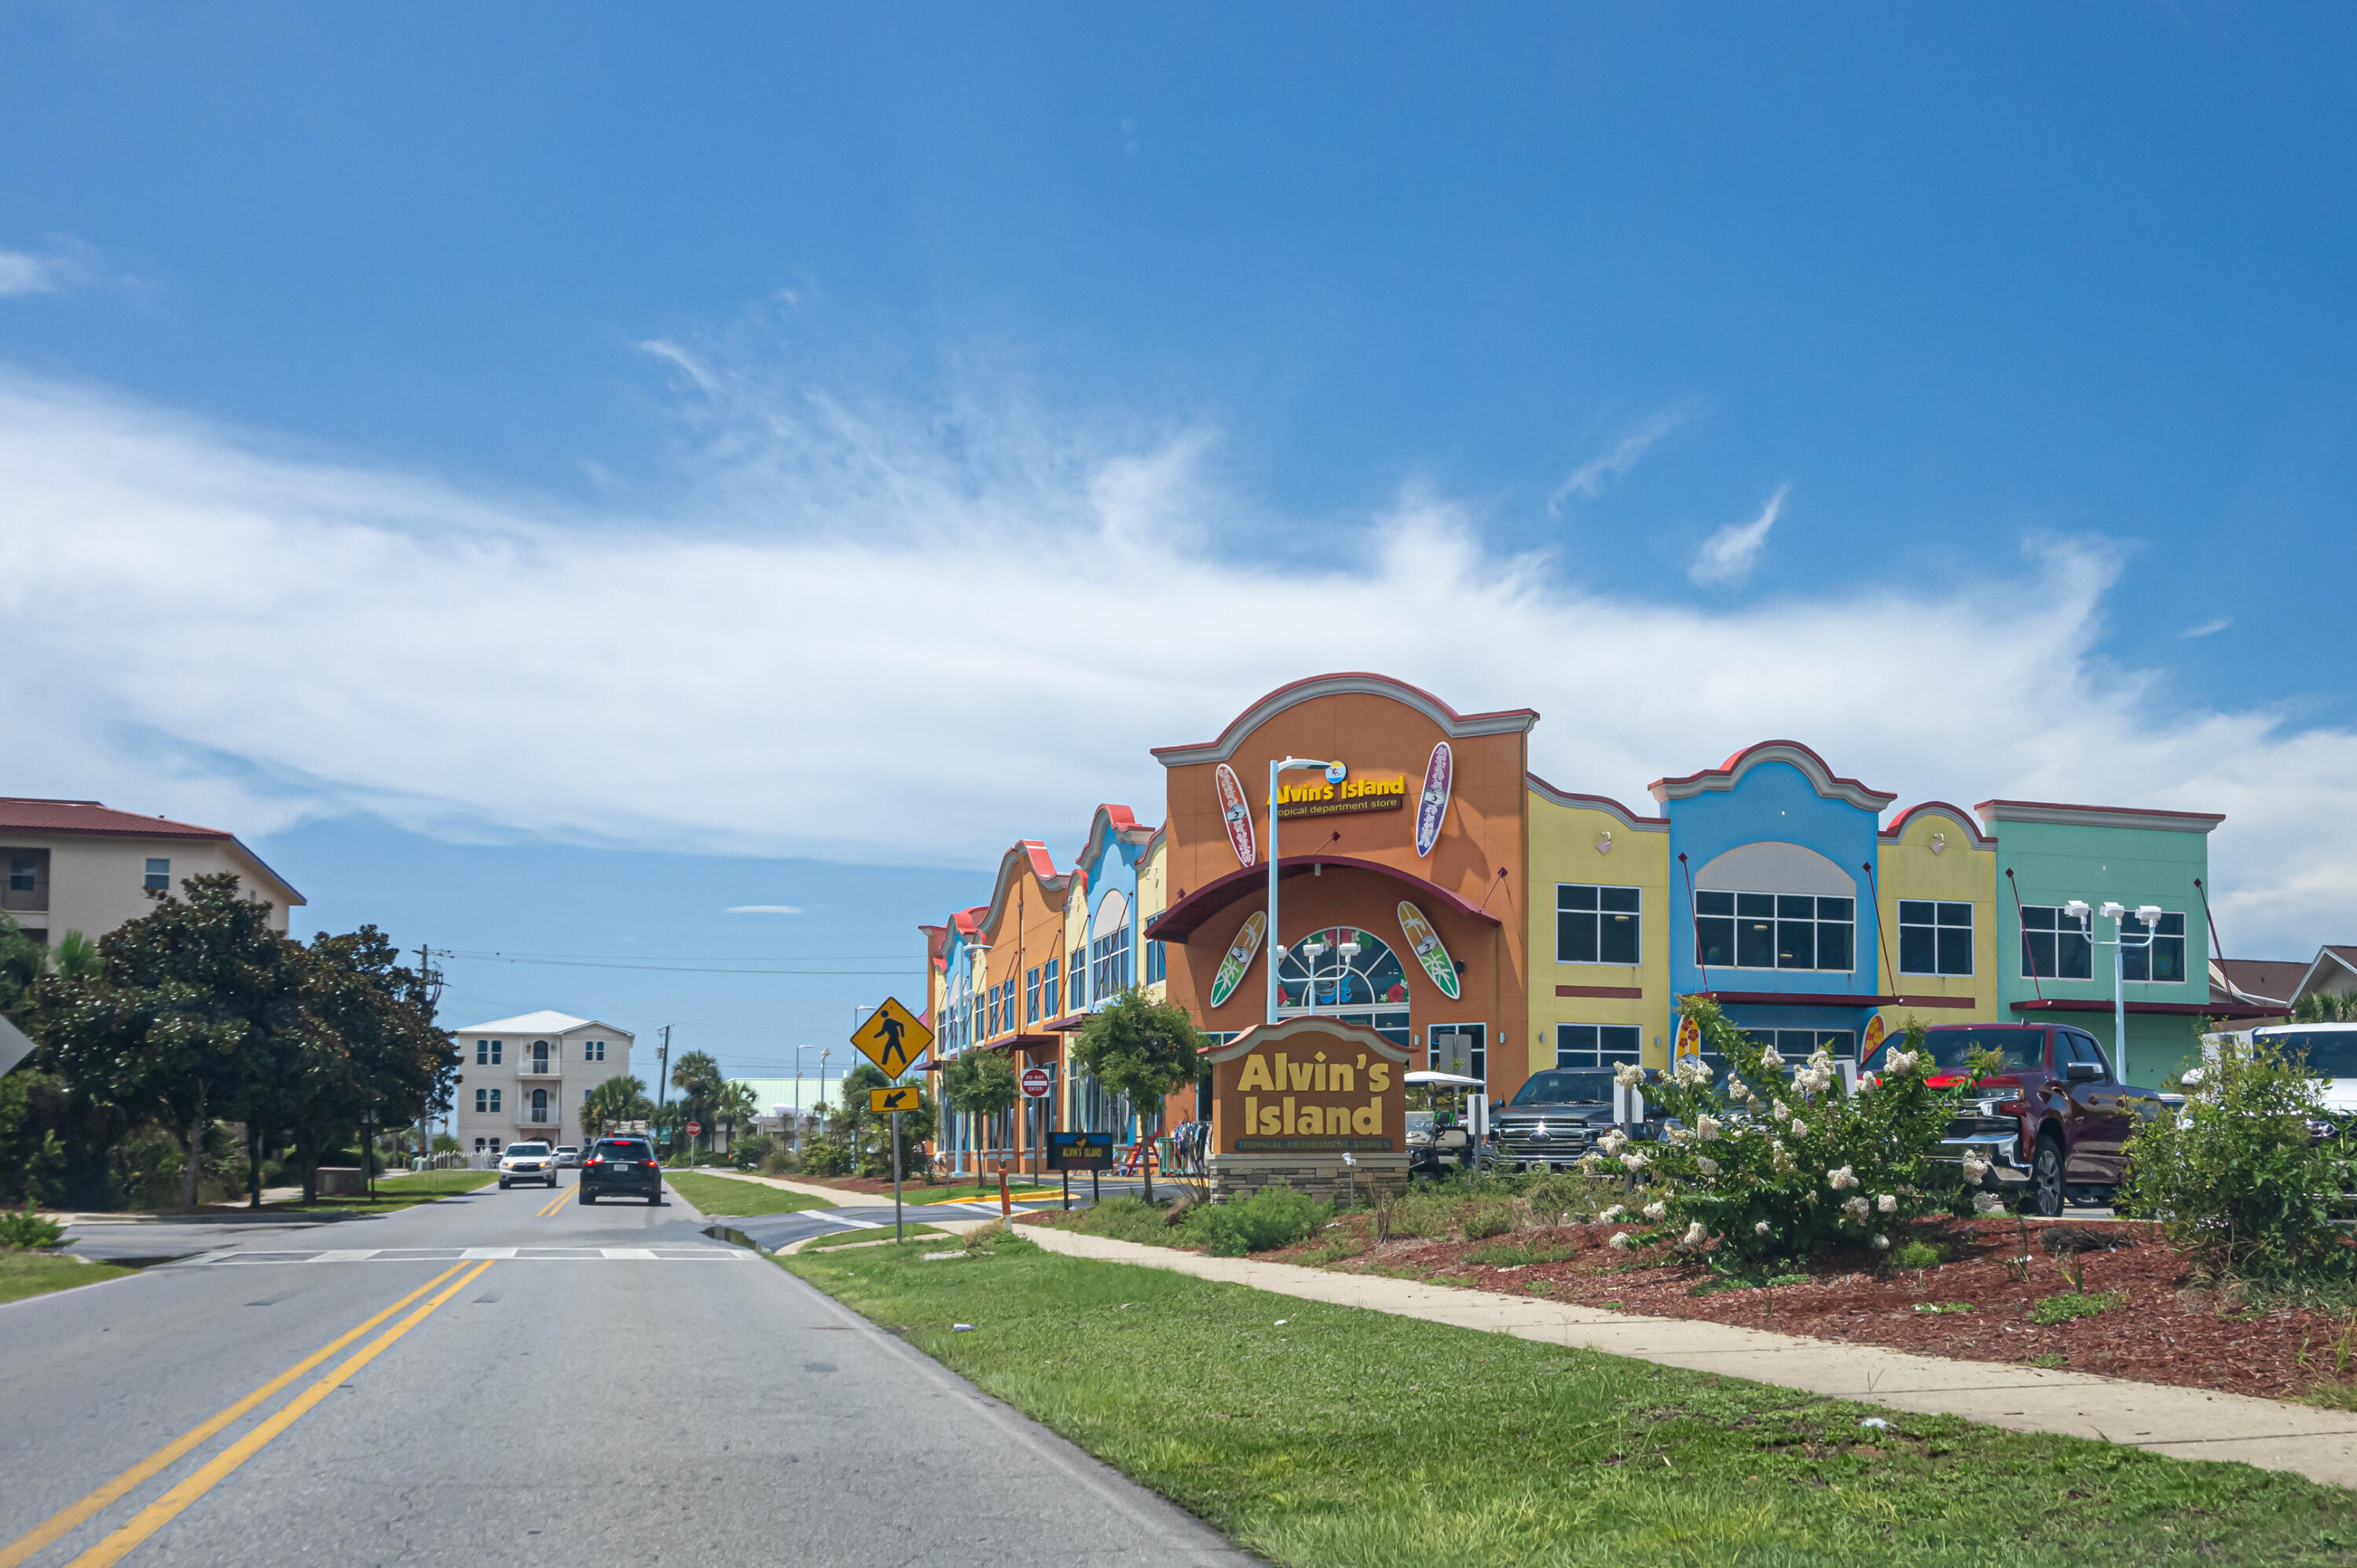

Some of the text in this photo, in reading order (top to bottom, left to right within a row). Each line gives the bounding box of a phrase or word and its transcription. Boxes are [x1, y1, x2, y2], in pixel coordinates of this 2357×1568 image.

[1341, 775, 1405, 799] Island
[1277, 799, 1397, 818] opical department store
[1237, 1050, 1391, 1093] Alvin's
[1244, 1096, 1383, 1136] Island
[1062, 1148, 1102, 1157] ALVIN'S ISLAND
[1238, 1140, 1391, 1149] TROPICAL DEPARTMENT STORES
